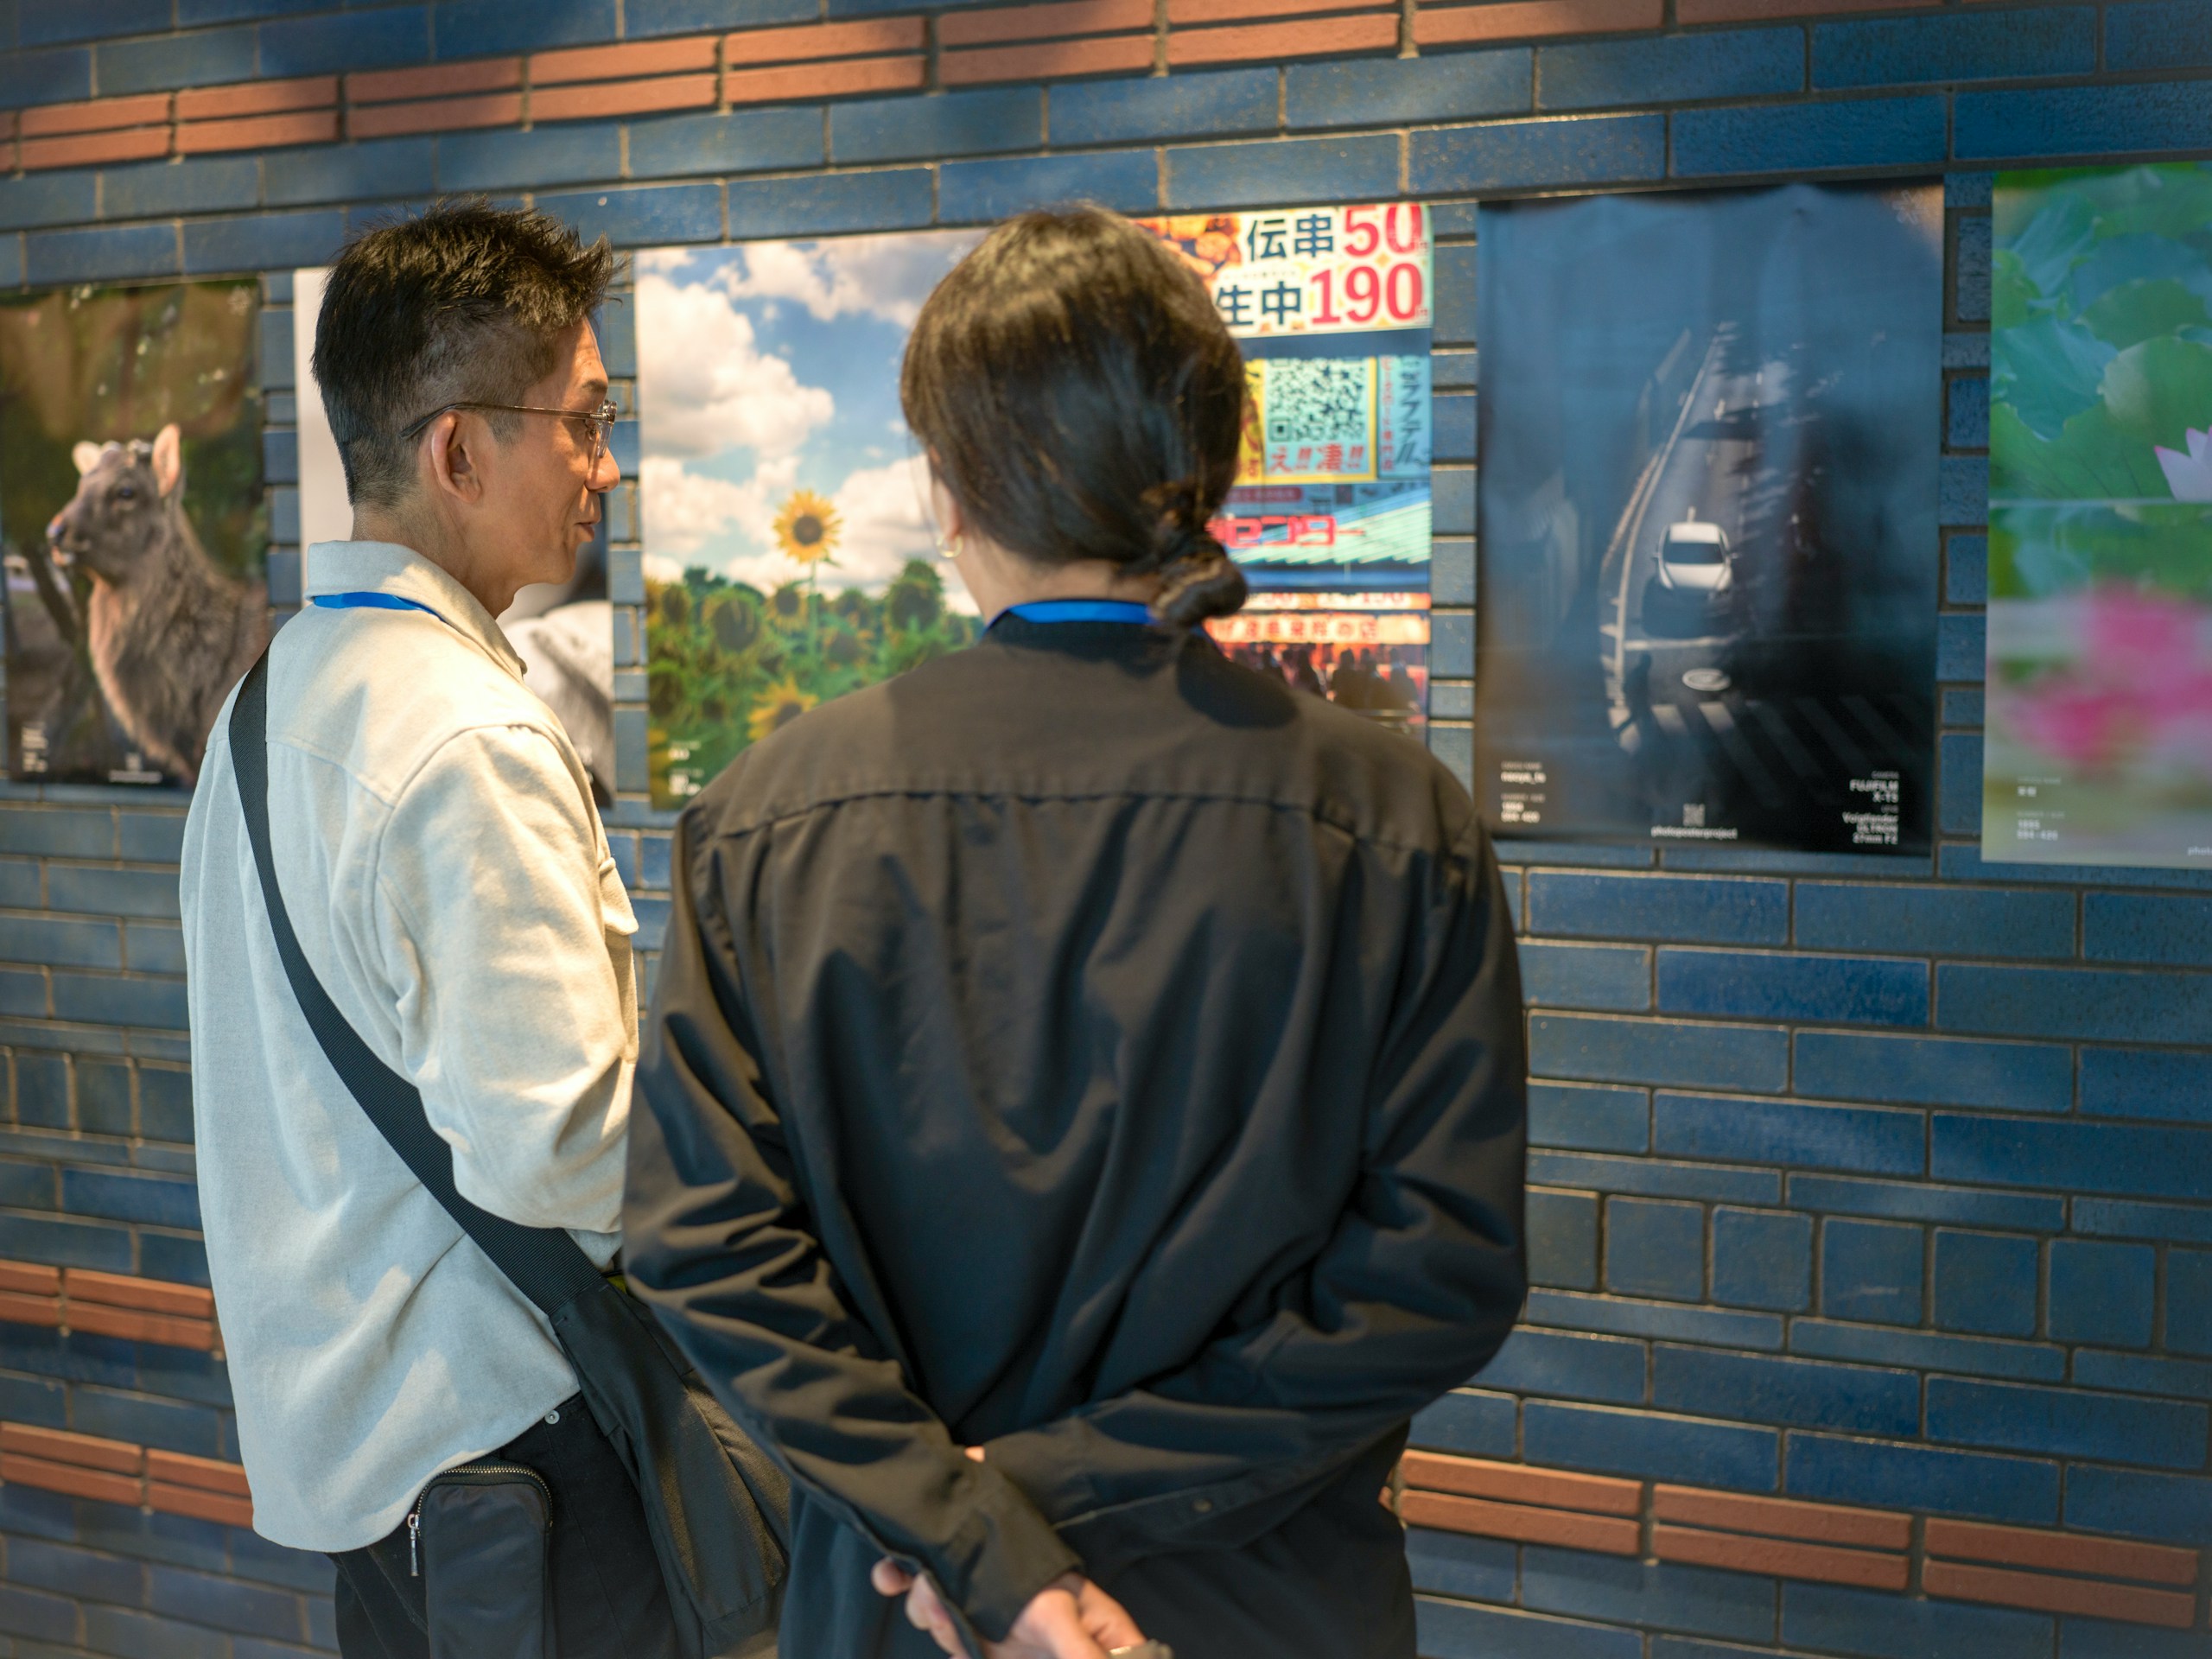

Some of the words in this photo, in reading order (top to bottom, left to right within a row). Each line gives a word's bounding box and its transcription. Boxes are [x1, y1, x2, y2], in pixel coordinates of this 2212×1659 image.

[1247, 213, 1334, 263] 伝串
[1216, 280, 1301, 327] 生中
[1310, 263, 1422, 325] 190
